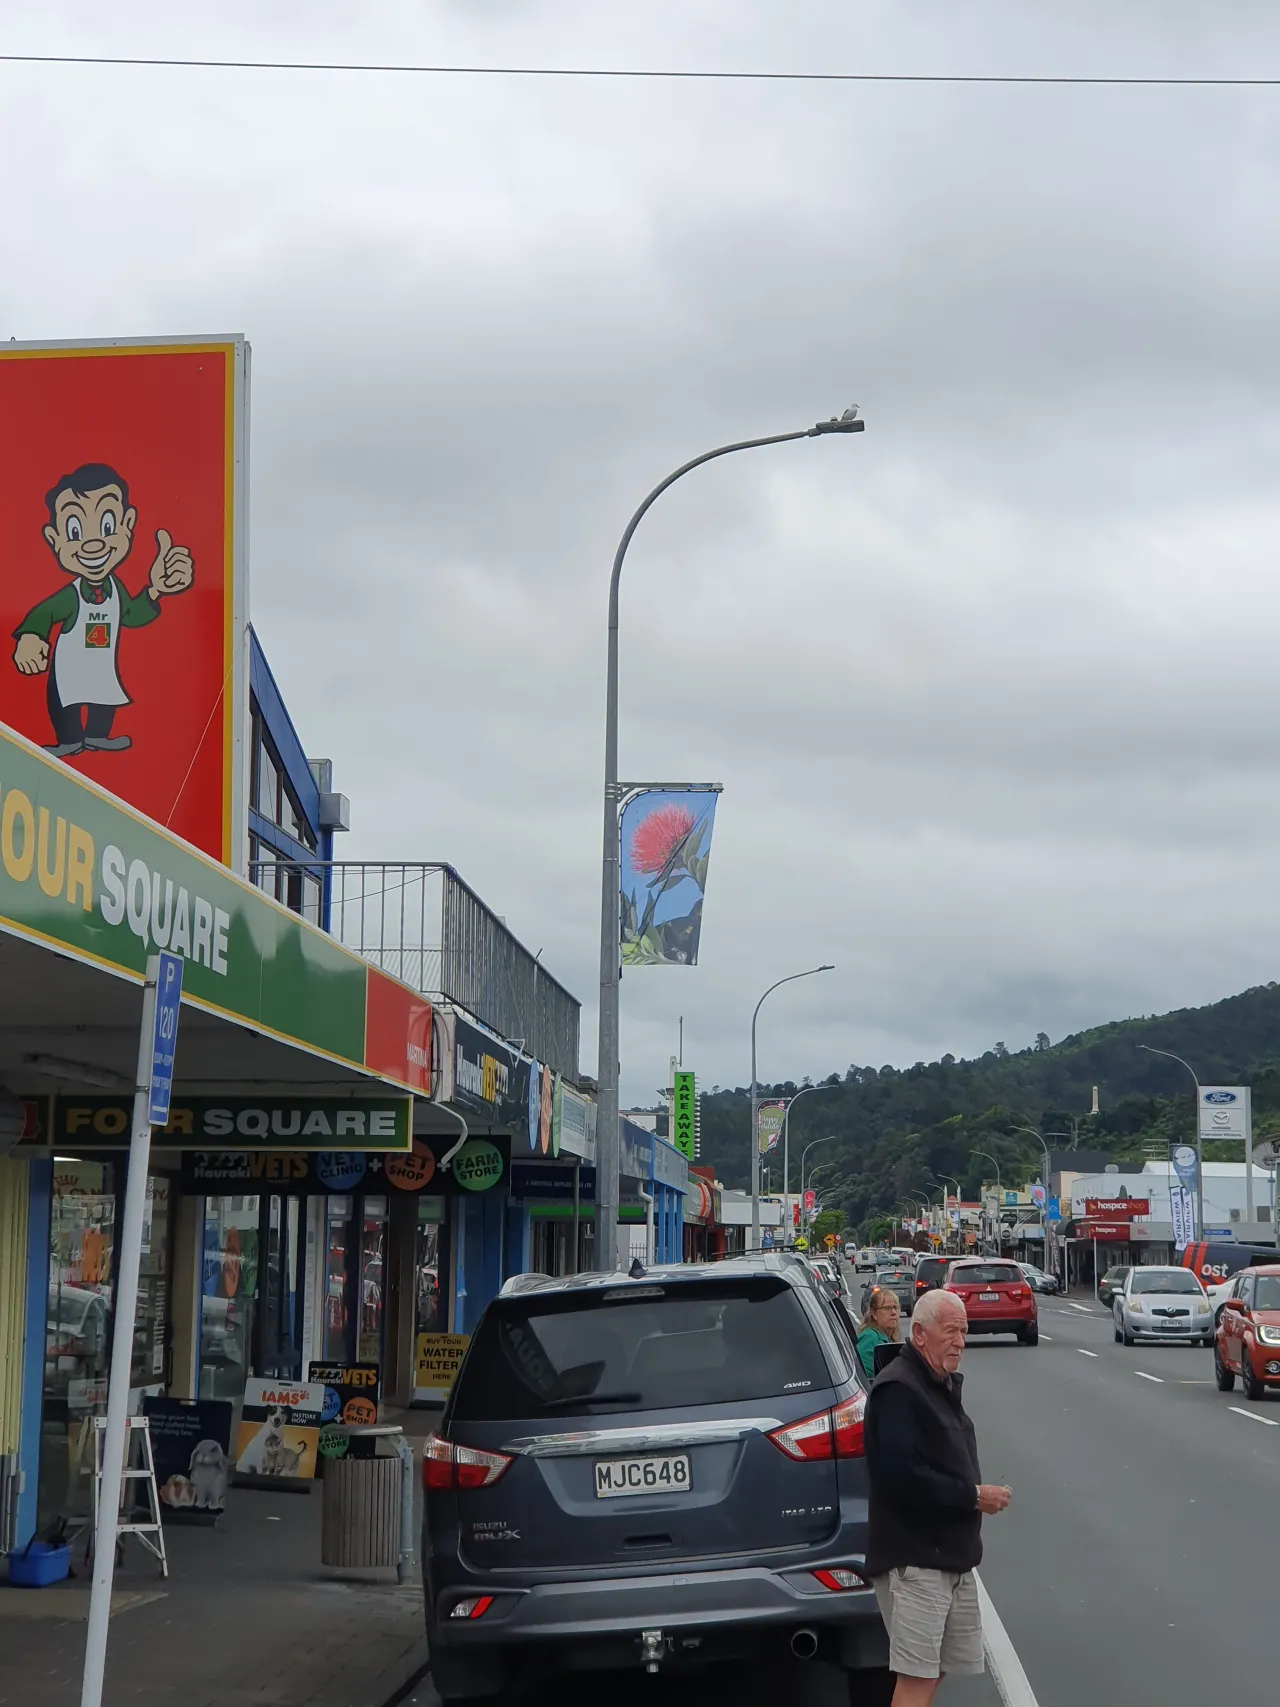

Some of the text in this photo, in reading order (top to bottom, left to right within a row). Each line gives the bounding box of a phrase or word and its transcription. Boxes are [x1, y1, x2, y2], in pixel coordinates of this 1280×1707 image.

[88, 612, 108, 622] Mr
[86, 623, 110, 647] 4
[0, 782, 230, 977] OUR SQUARE
[165, 961, 175, 993] P
[159, 1006, 174, 1040] 120
[66, 1107, 396, 1140] FOR SQUARE
[250, 1152, 309, 1179] VETS
[456, 1151, 500, 1171] FARM
[194, 1166, 250, 1179] Hauraki
[320, 1164, 362, 1179] CLINIC
[389, 1164, 424, 1182] SHOP
[460, 1165, 500, 1180] STORE
[1097, 1201, 1127, 1211] hospice
[1095, 1226, 1117, 1234] hospice
[423, 1347, 464, 1358] WATER
[419, 1360, 459, 1370] FILTER
[343, 1368, 377, 1385] VETS
[261, 1390, 300, 1406] IAMS
[292, 1412, 317, 1420] INSTORE
[346, 1403, 374, 1417] PET
[345, 1414, 370, 1425] SHOP
[320, 1439, 347, 1451] STORE
[597, 1460, 687, 1490] MJC648
